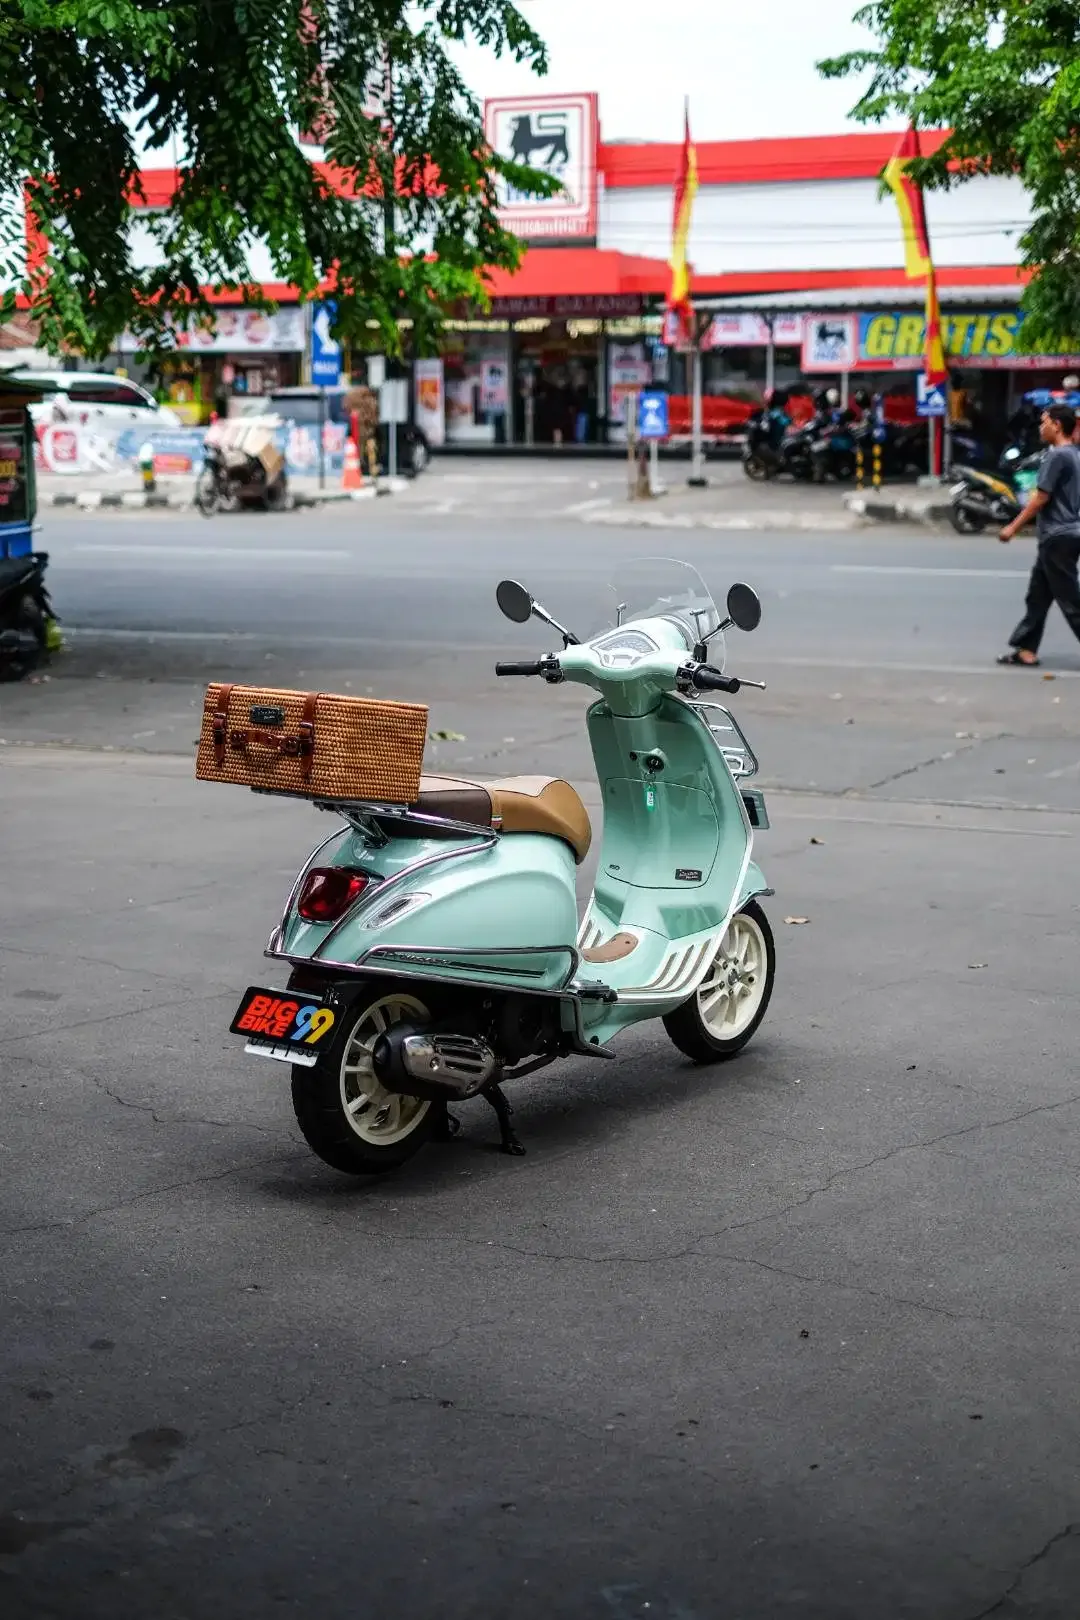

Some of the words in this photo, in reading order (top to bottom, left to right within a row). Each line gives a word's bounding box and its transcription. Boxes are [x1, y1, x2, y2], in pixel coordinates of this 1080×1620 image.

[246, 995, 300, 1022] BIG
[237, 1014, 289, 1038] BIKE
[290, 1005, 335, 1044] 99
